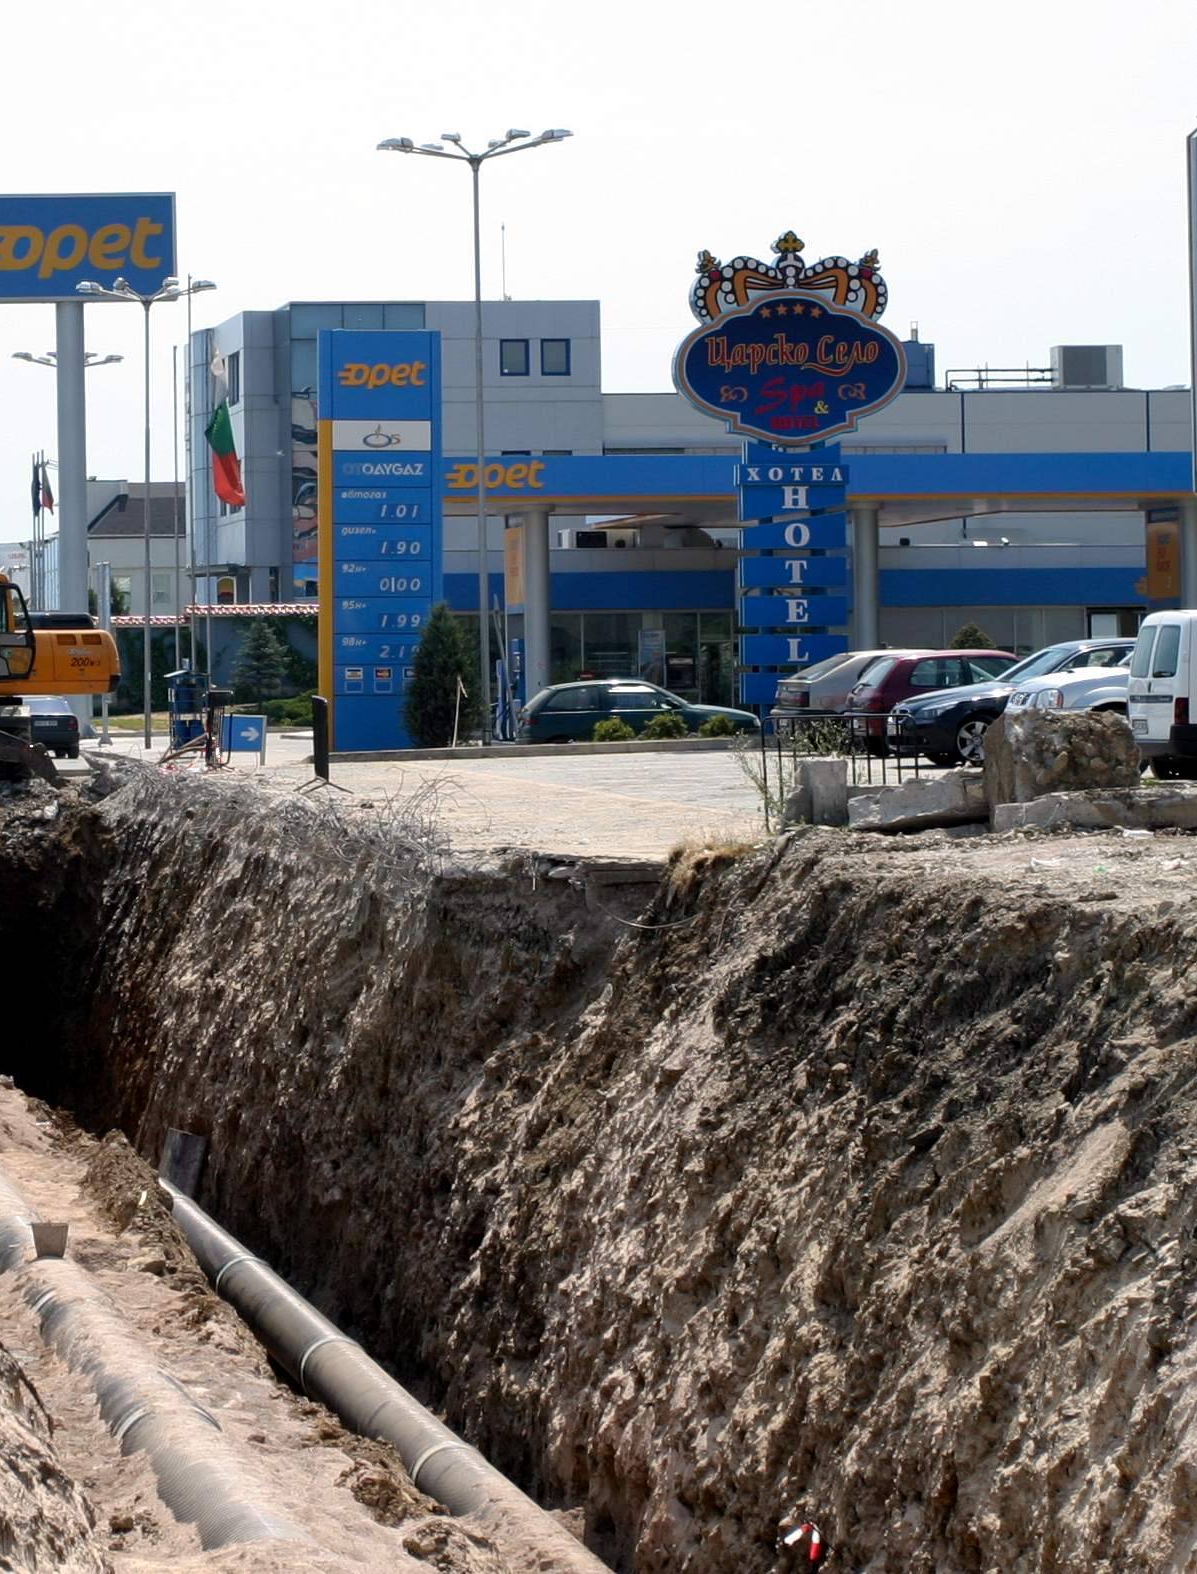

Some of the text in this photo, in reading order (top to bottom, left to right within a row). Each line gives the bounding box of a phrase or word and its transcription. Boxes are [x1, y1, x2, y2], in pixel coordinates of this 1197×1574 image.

[705, 333, 879, 377] Царско Село
[337, 360, 427, 390] opet
[755, 376, 829, 415] Spa &
[746, 467, 843, 481] ХОТЕЛ
[380, 504, 419, 518] 1.01
[380, 541, 421, 555] 1.90
[782, 486, 811, 662] HOTEL
[380, 614, 421, 628] 1.99
